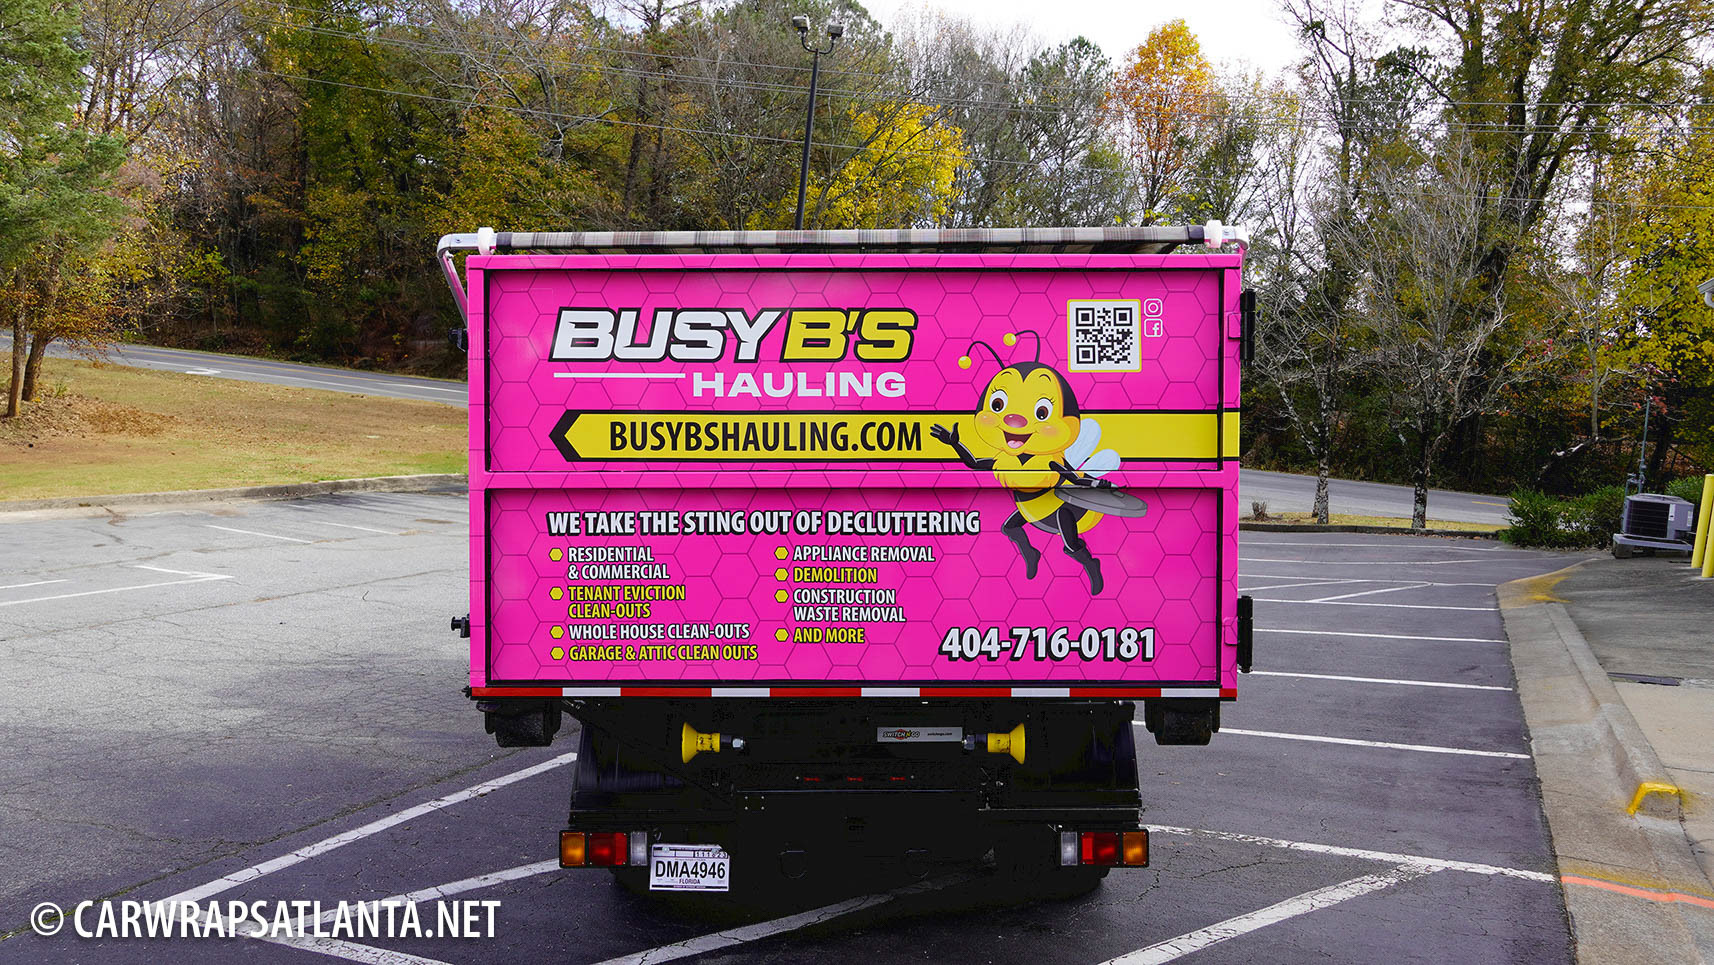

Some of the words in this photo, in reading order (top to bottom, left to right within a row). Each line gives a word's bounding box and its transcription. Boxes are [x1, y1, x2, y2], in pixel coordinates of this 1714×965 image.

[548, 307, 785, 363] BUSY
[780, 307, 918, 363] B'S
[692, 372, 906, 398] HAULING
[609, 421, 922, 452] BUSYBSHAULING.COM
[546, 511, 581, 536] WE
[584, 511, 636, 536] TAKE
[638, 511, 680, 536] THE
[682, 511, 746, 536] STING
[748, 511, 792, 535] OUT
[794, 511, 822, 535] OF
[826, 511, 980, 535] DECLUTTERING
[568, 547, 654, 563] RESIDENTIAL
[793, 546, 868, 562] APPLIANCE
[870, 546, 935, 562] REMOVAL
[568, 565, 579, 580] &
[581, 564, 670, 580] COMMERCIAL
[793, 567, 878, 583] DEMOLITION
[568, 586, 621, 601] TENANT
[623, 585, 686, 601] EVICTION
[793, 589, 896, 605] CONSTRUCTION
[568, 603, 651, 619] CLEAN-OUTS
[793, 606, 839, 622] WASTE
[842, 606, 907, 622] REMOVAL
[569, 625, 617, 640] WHOLE
[620, 625, 665, 640] HOUSE
[667, 624, 750, 640] CLEAN-OUTS
[793, 628, 823, 643] AND
[825, 628, 865, 643] MORE
[938, 626, 1155, 662] 404-716-0181
[569, 646, 623, 661] GARAGE
[625, 646, 636, 660] &
[638, 645, 676, 660] ATTIC
[678, 645, 720, 660] CLEAN
[722, 645, 758, 660] OUTS
[655, 861, 726, 879] DMA4946
